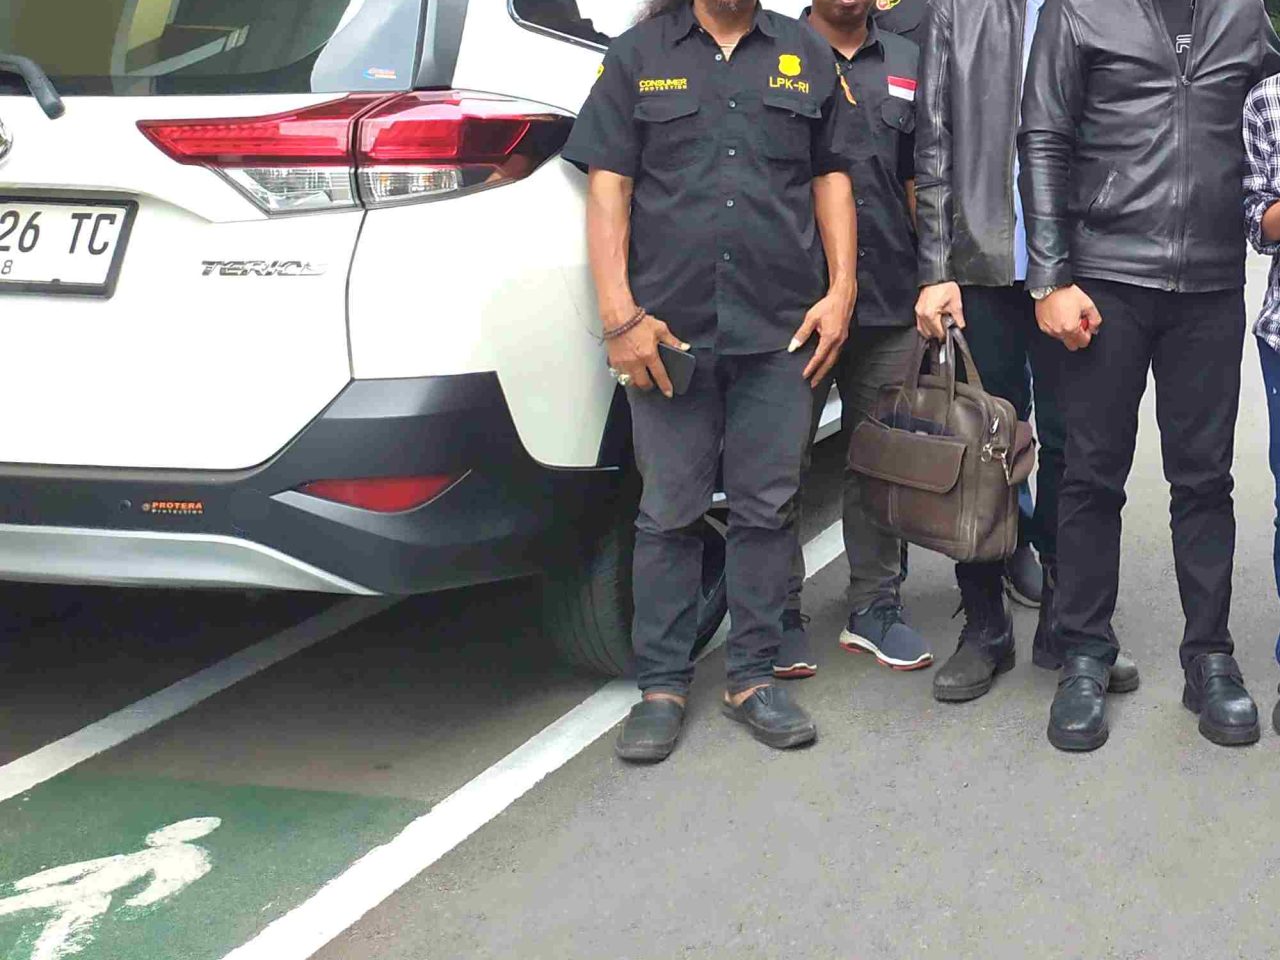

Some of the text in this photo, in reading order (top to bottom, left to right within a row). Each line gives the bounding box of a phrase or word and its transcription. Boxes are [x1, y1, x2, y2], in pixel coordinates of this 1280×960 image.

[639, 79, 687, 88] CONSUMER
[769, 76, 810, 95] LPK-RI
[69, 212, 117, 255] TC
[1, 259, 13, 275] 8
